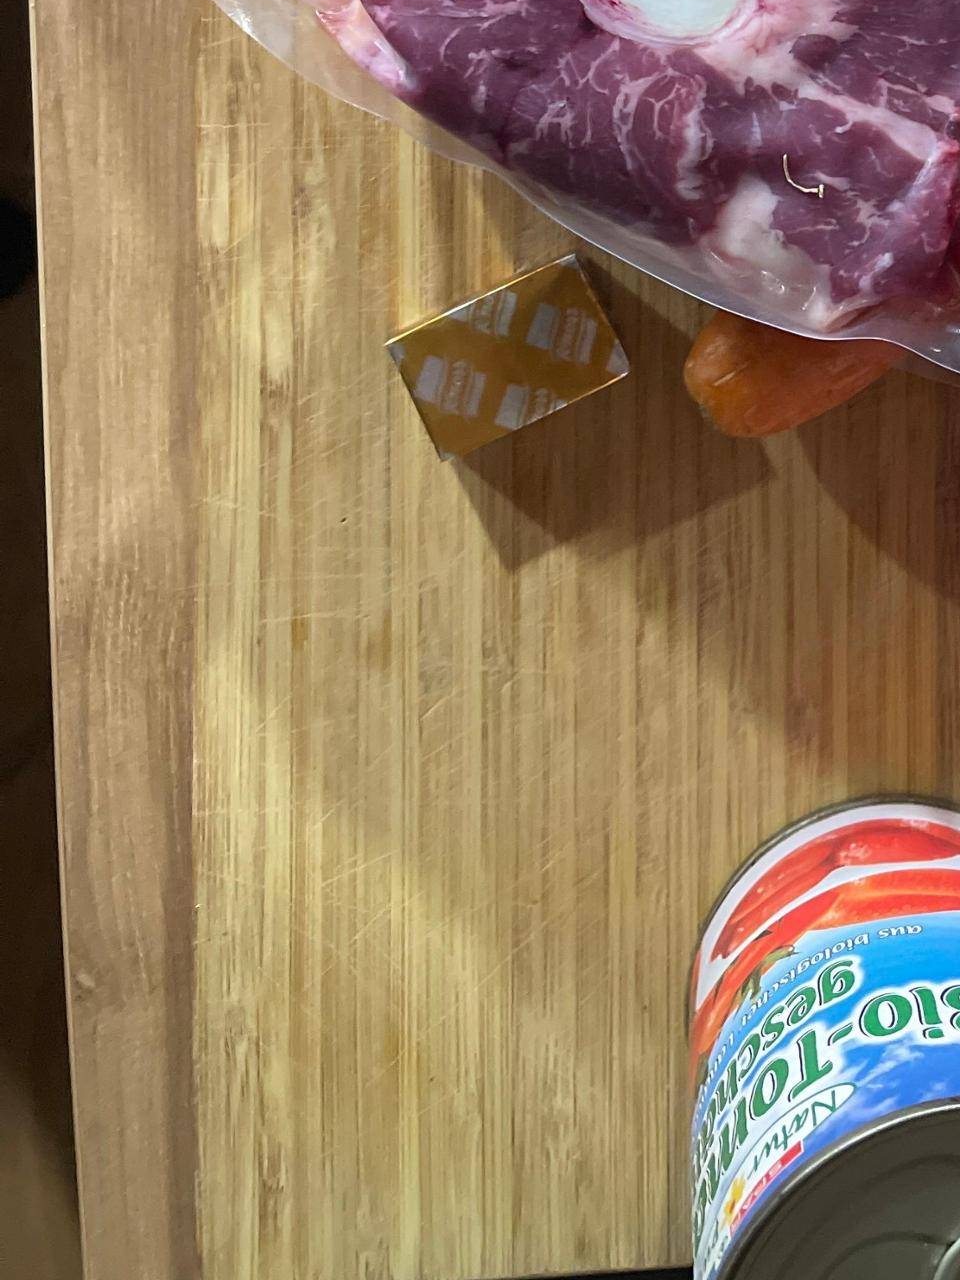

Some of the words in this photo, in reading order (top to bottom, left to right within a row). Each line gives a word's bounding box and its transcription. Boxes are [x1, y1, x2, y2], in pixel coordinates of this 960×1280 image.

[876, 925, 923, 941] aus
[740, 932, 869, 1027] biologischer
[747, 1091, 837, 1181] Natur
